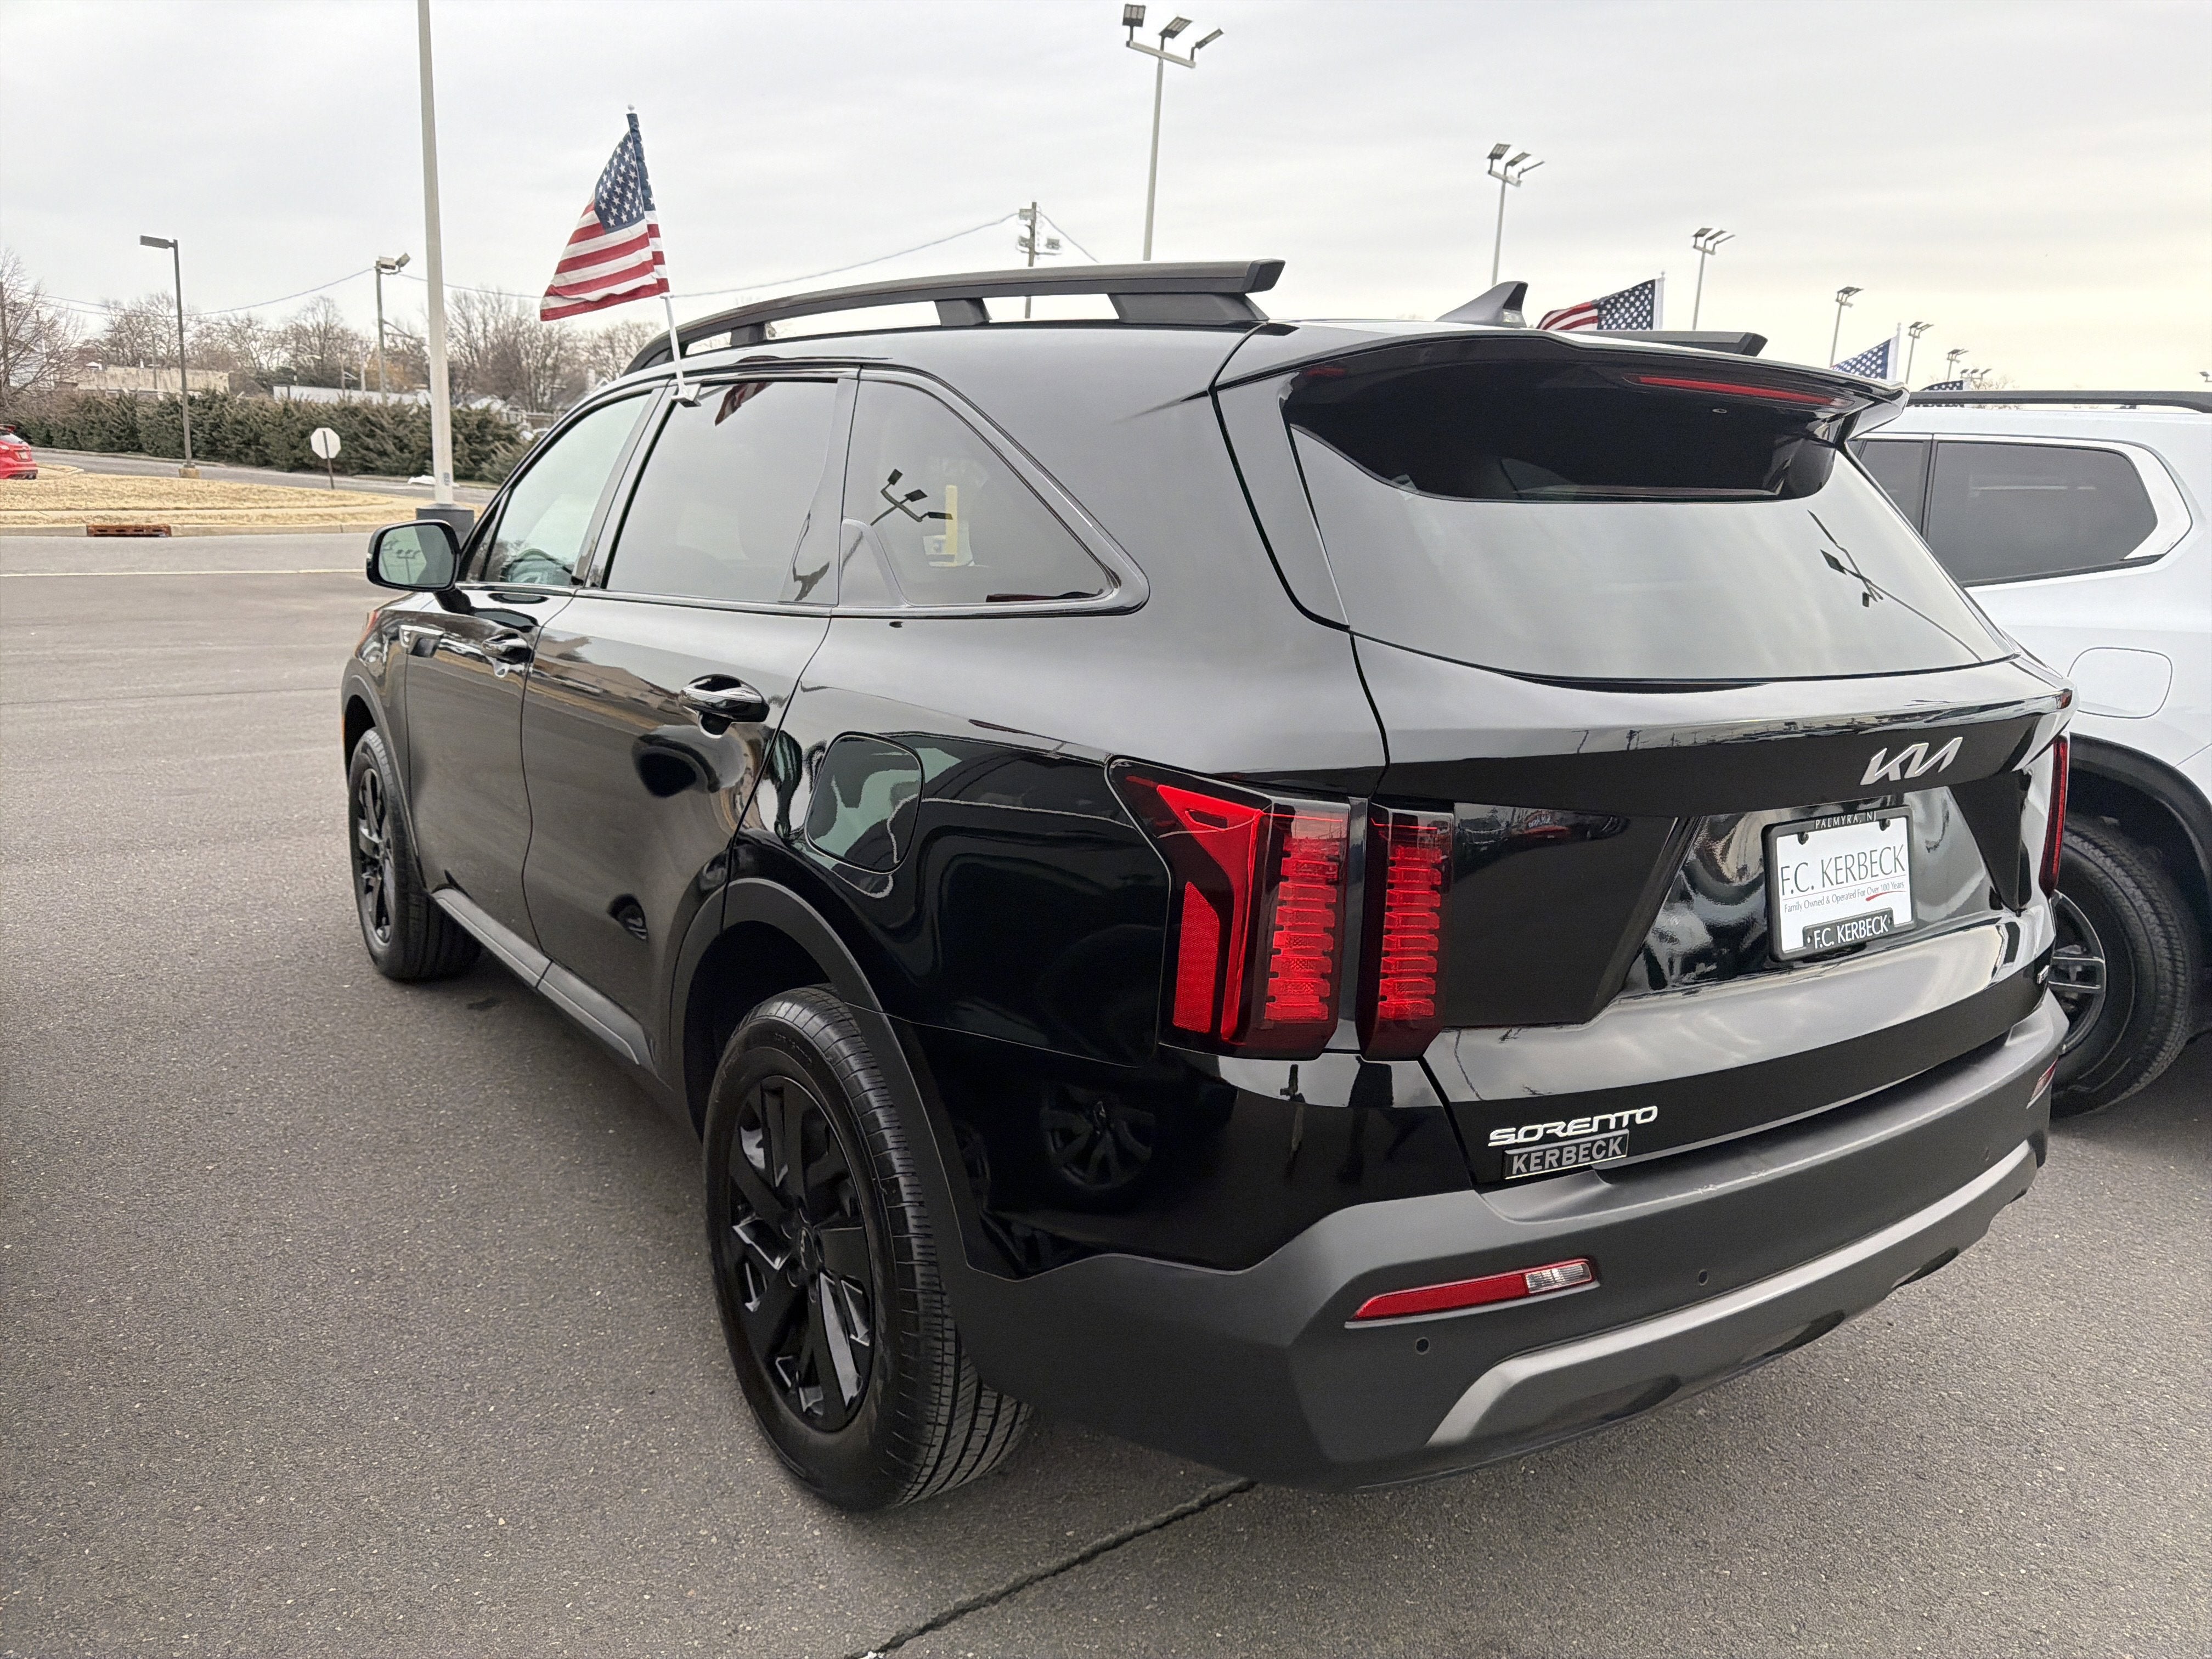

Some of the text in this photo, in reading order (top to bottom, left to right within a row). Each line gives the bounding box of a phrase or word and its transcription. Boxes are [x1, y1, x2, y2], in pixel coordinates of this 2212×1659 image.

[1860, 736, 1963, 786] KIA
[1815, 811, 1876, 829] PALMYRA, NJ
[1780, 844, 1905, 896] F.C. KERBECK
[1784, 881, 1904, 913] Family Owned & Operated For Over 100 Years
[1814, 914, 1889, 949] F.C. KERBECK
[1487, 1105, 1658, 1147] SORENTO
[1511, 1136, 1625, 1175] KERBECK
